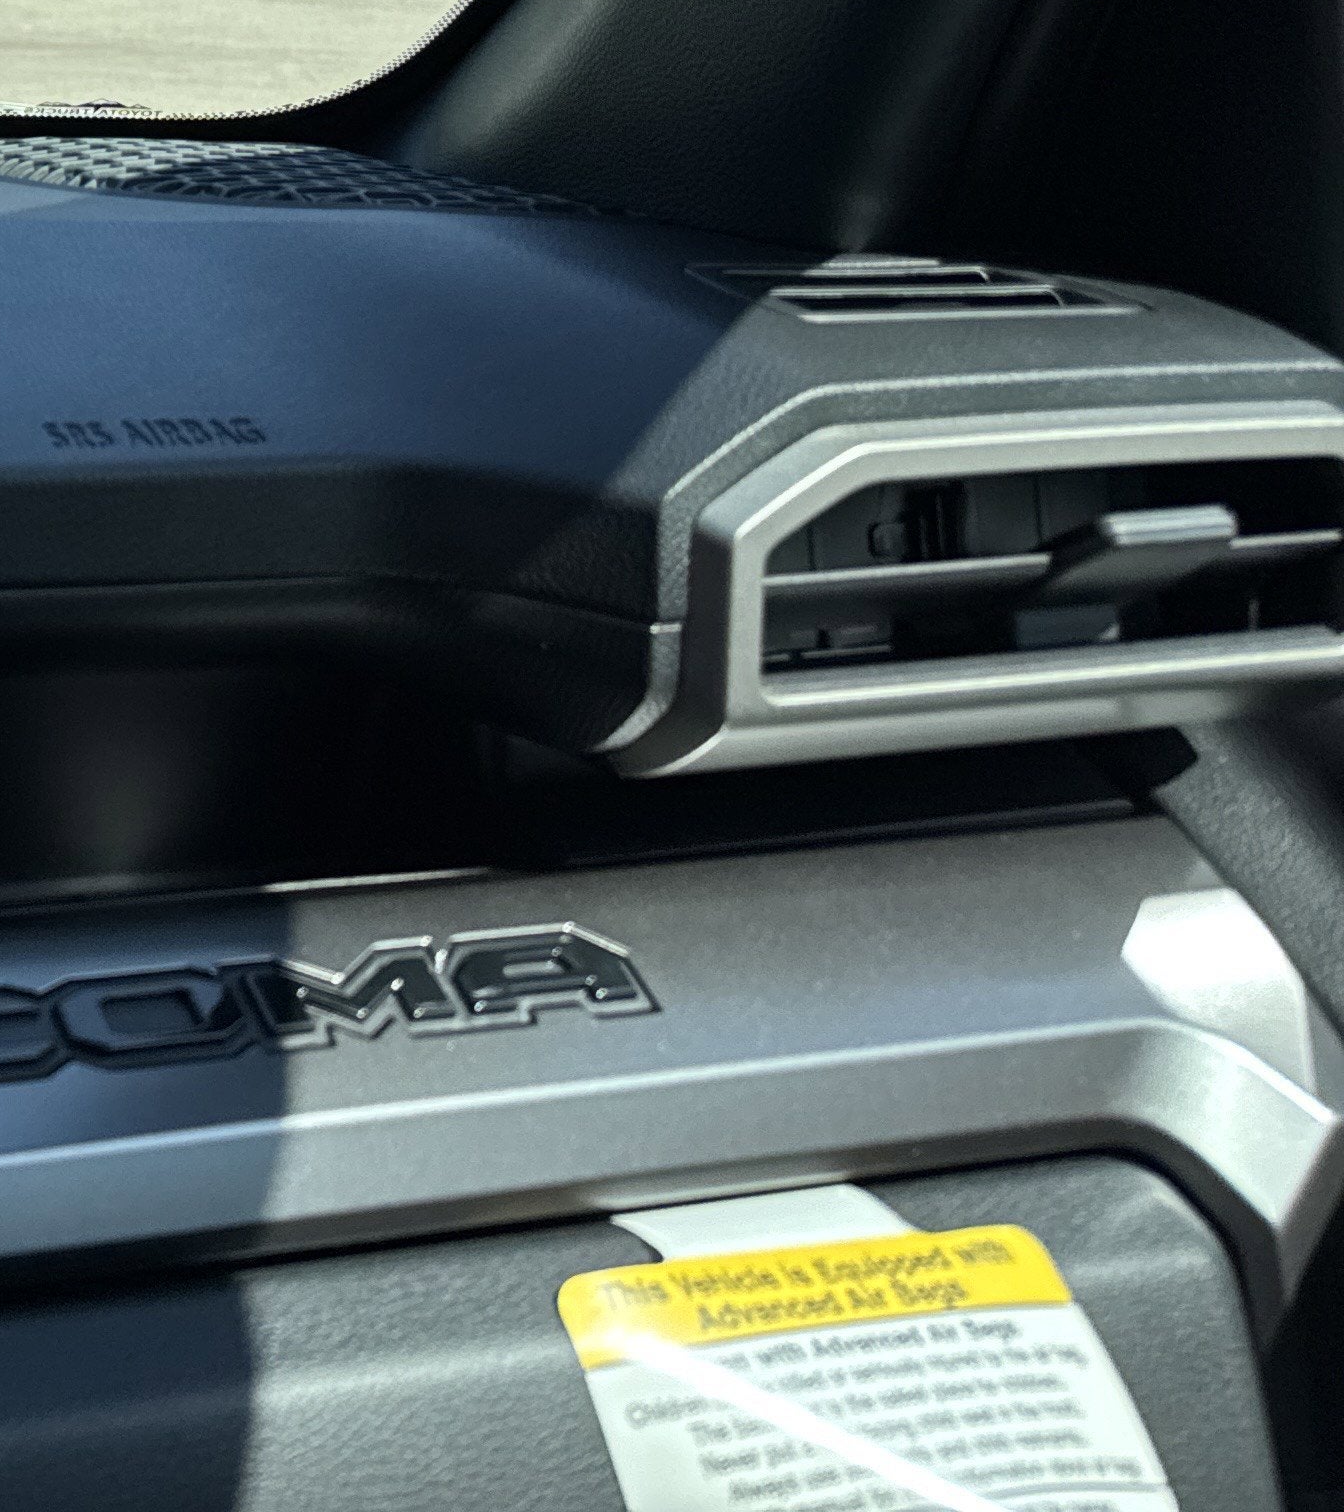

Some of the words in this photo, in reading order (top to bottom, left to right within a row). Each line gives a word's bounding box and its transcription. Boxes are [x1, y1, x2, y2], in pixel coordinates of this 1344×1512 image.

[41, 420, 114, 449] SRS
[120, 417, 266, 449] AIRBAG
[602, 1280, 668, 1310] This
[668, 1267, 779, 1298] Vehicle
[812, 1247, 953, 1284] Equipped
[953, 1240, 1016, 1267] with
[696, 1292, 844, 1331] Advanced
[846, 1287, 887, 1310] Air
[891, 1279, 968, 1310] Bags
